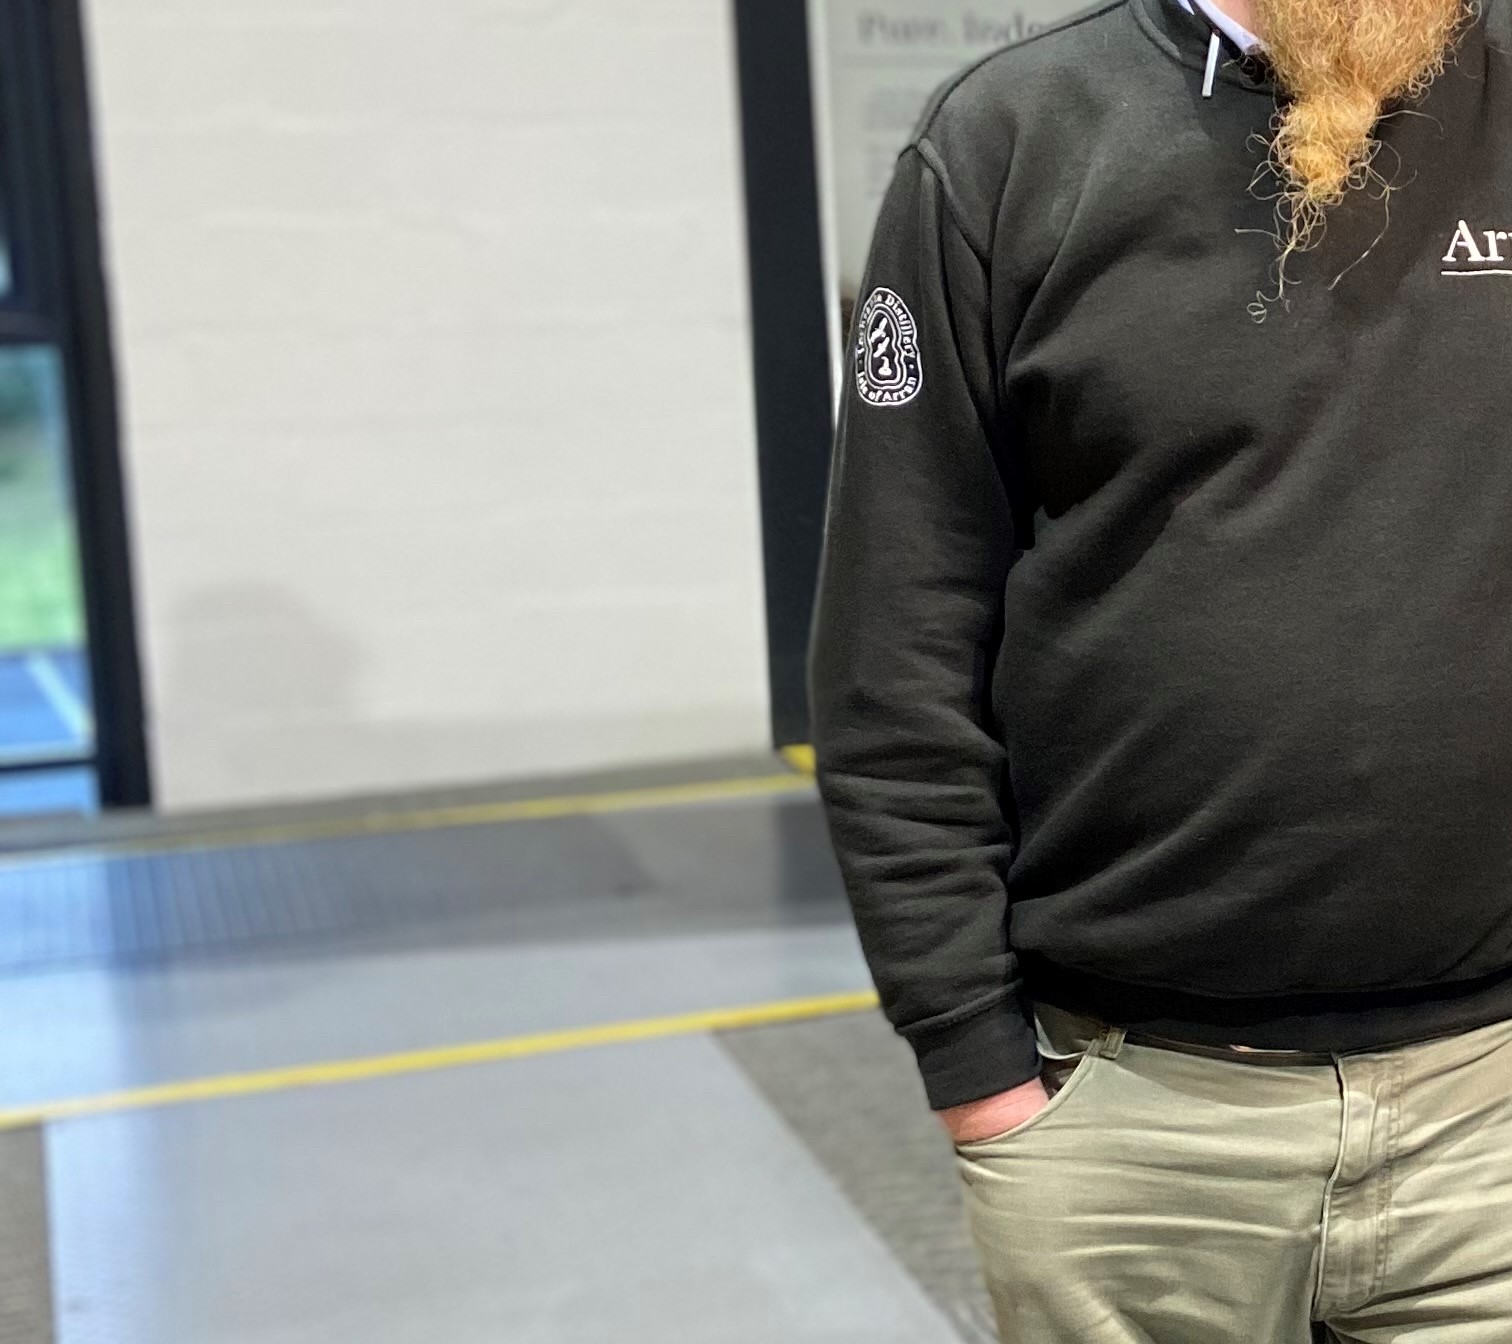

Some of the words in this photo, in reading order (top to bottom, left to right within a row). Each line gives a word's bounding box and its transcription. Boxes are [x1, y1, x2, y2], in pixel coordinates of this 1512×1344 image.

[884, 293, 916, 359] Distillery
[857, 371, 869, 395] Isle
[868, 391, 884, 402] of
[882, 377, 917, 402] Arran
